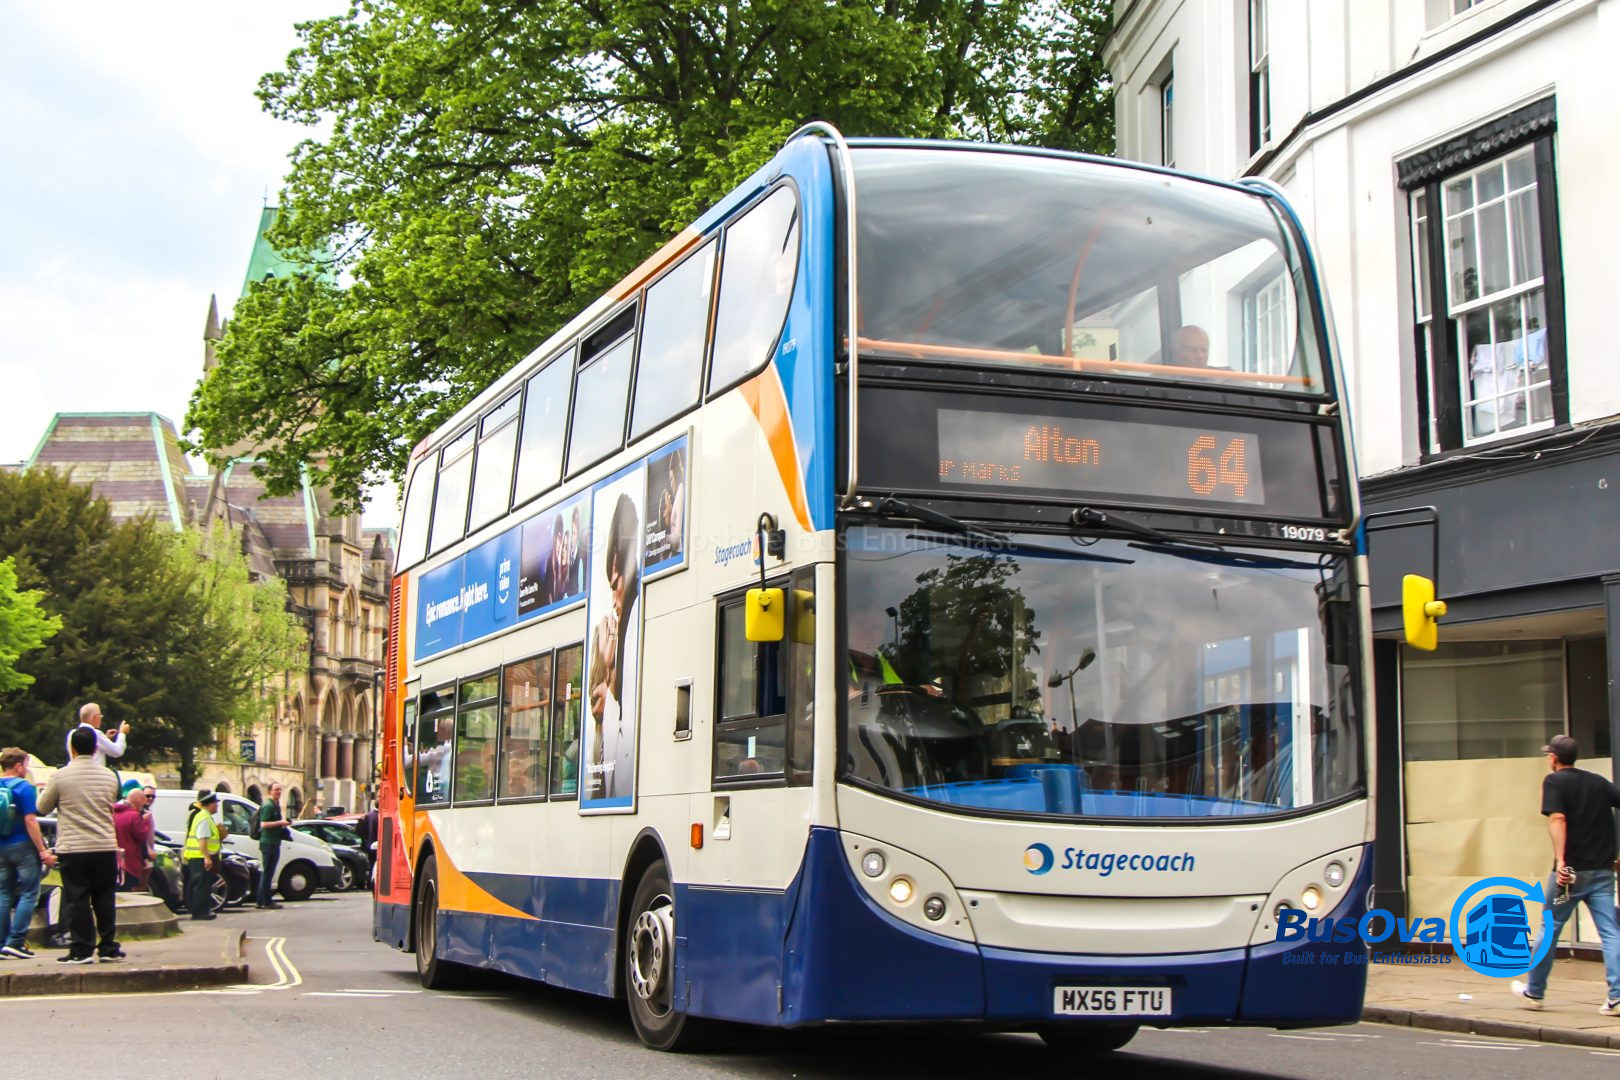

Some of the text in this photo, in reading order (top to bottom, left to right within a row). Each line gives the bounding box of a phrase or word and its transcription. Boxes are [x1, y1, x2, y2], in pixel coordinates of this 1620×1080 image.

[1023, 424, 1100, 466] Alton
[1188, 434, 1249, 497] 64
[1281, 525, 1326, 541] 19079
[714, 537, 752, 567] Stagecoach
[1060, 846, 1196, 878] Stagecoach
[1062, 989, 1164, 1012] MX56 FTU
